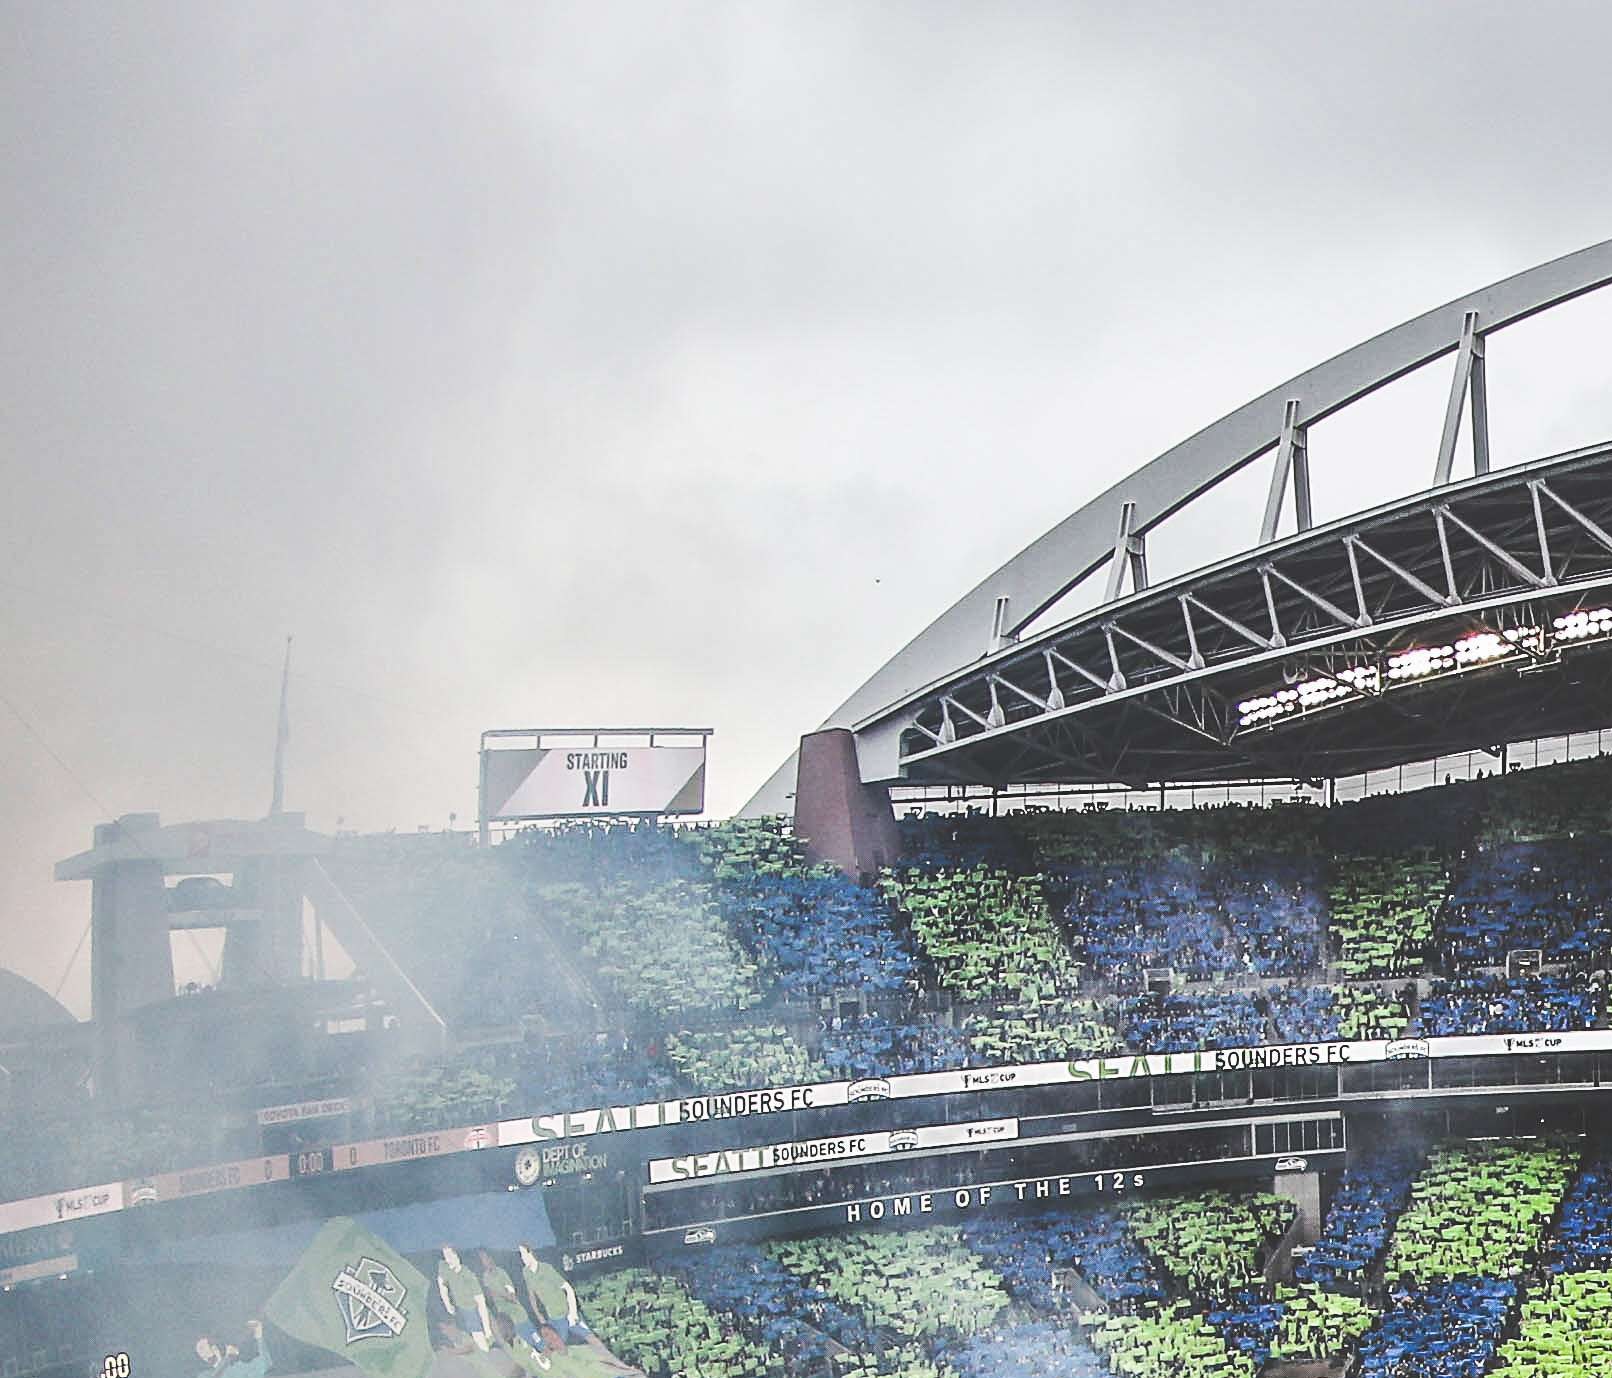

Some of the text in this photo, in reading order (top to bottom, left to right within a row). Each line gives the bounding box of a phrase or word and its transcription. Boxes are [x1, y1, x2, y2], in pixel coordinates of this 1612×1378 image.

[567, 753, 628, 769] STARTING
[583, 770, 609, 806] XI
[1545, 1037, 1562, 1047] CUP
[1215, 1045, 1350, 1069] SOUNDERS FC
[973, 1073, 1016, 1085] MLS CUP
[679, 1087, 814, 1122] SOUNDERS FC
[426, 1136, 440, 1153] FC
[543, 1144, 590, 1164] DEPT OF
[772, 1138, 866, 1165] SOUNDERS FC
[847, 1173, 1144, 1223] HOME OF THE 12s
[575, 1246, 624, 1264] STARBUCKS
